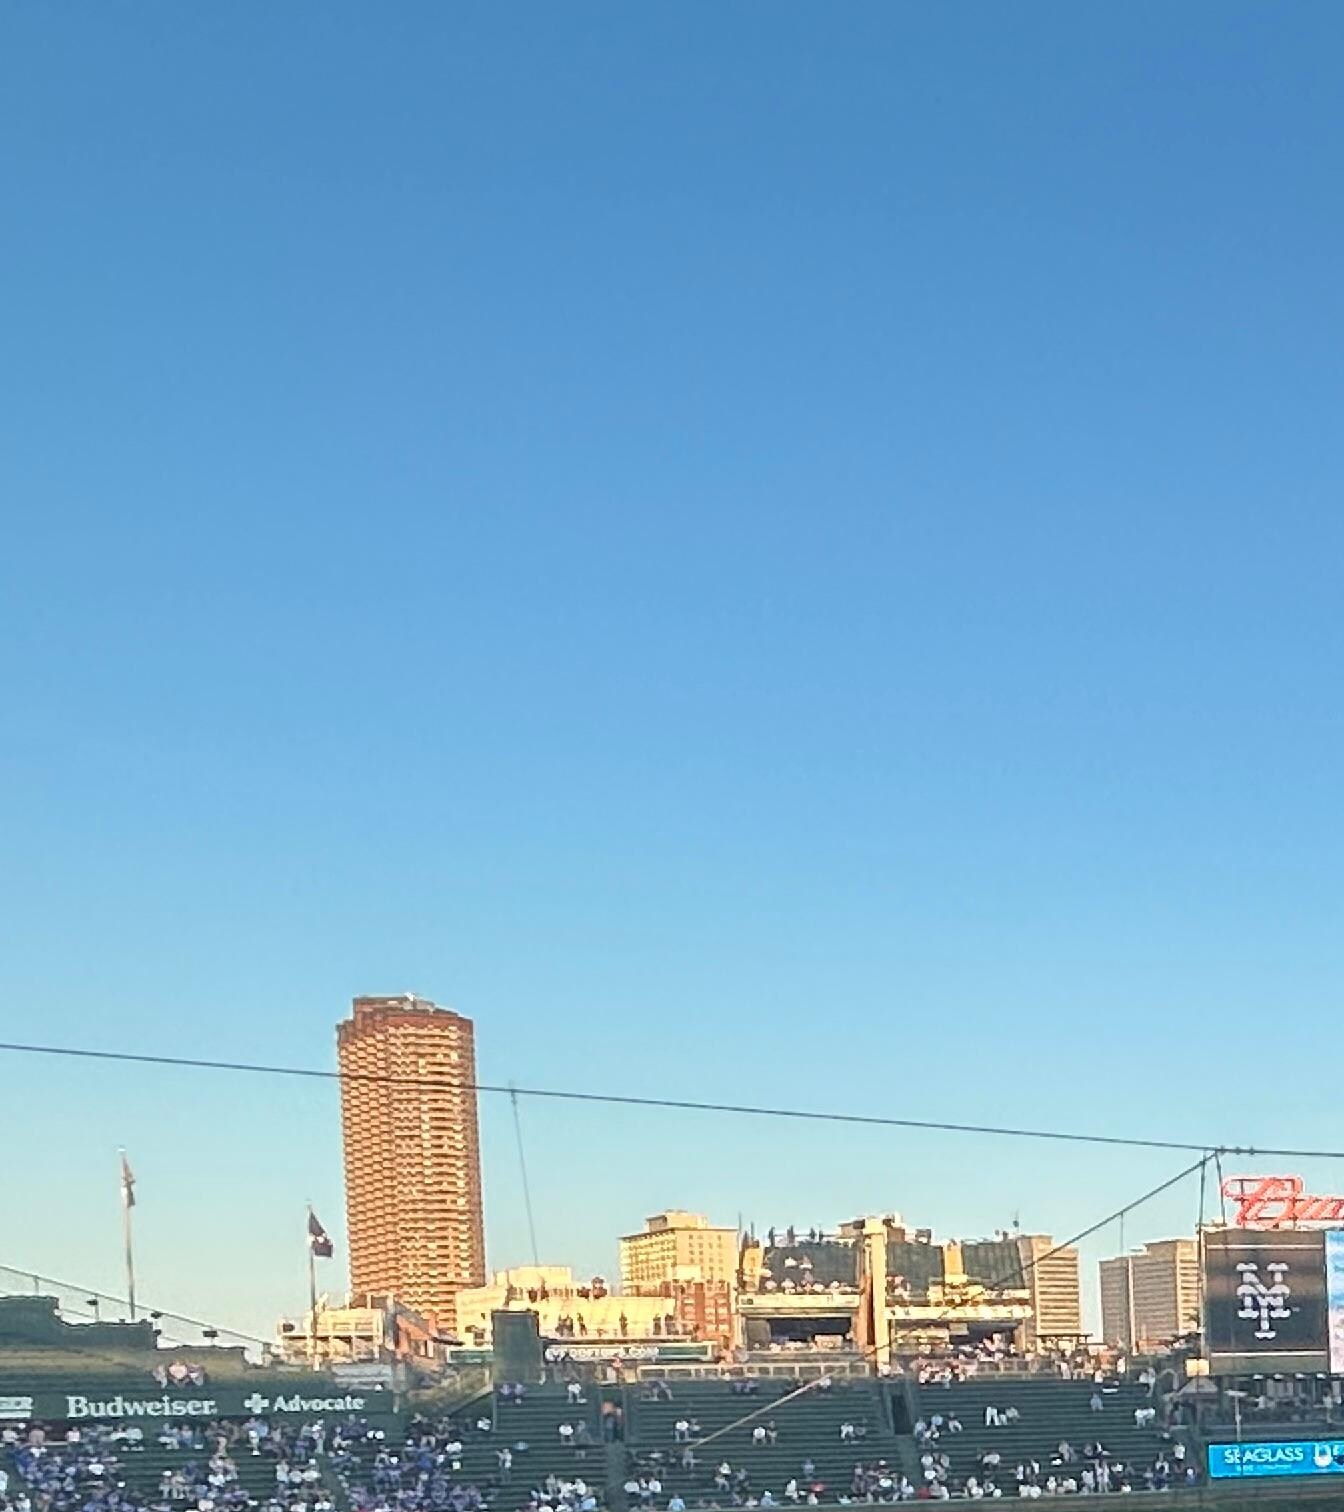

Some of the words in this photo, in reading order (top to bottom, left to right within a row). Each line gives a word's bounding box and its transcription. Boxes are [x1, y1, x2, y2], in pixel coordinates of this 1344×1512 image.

[66, 1395, 214, 1418] Budweiser
[272, 1395, 366, 1413] Advocate
[1224, 1448, 1304, 1464] SEAGLASS
